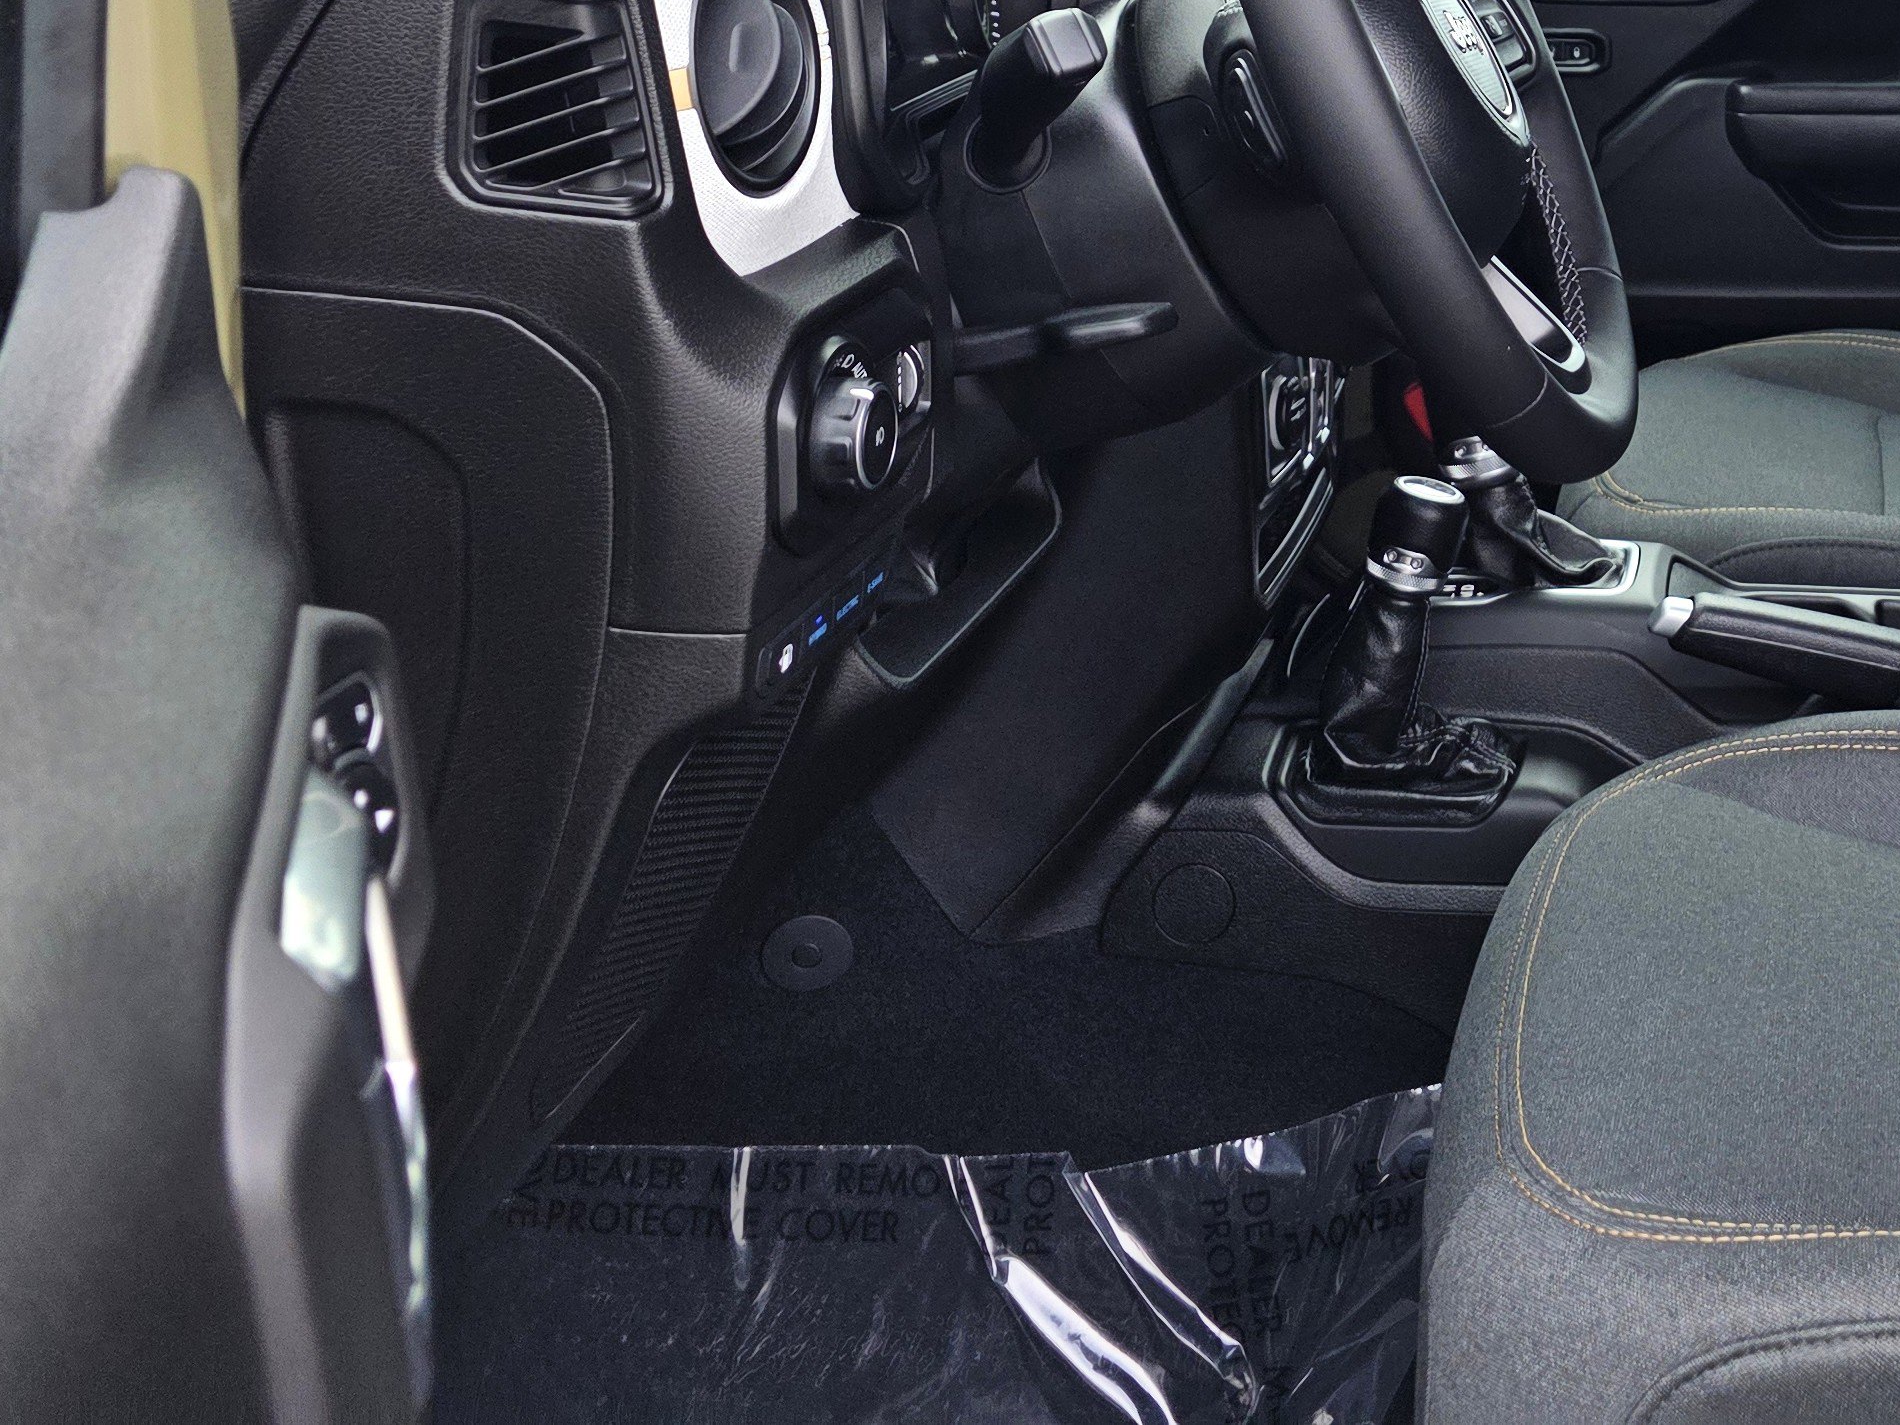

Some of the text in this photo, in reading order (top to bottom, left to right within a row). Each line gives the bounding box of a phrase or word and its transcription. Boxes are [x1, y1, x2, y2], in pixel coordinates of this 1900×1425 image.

[552, 1152, 686, 1191] DEALER
[835, 1160, 941, 1198] REMO
[778, 1207, 900, 1244] COVER
